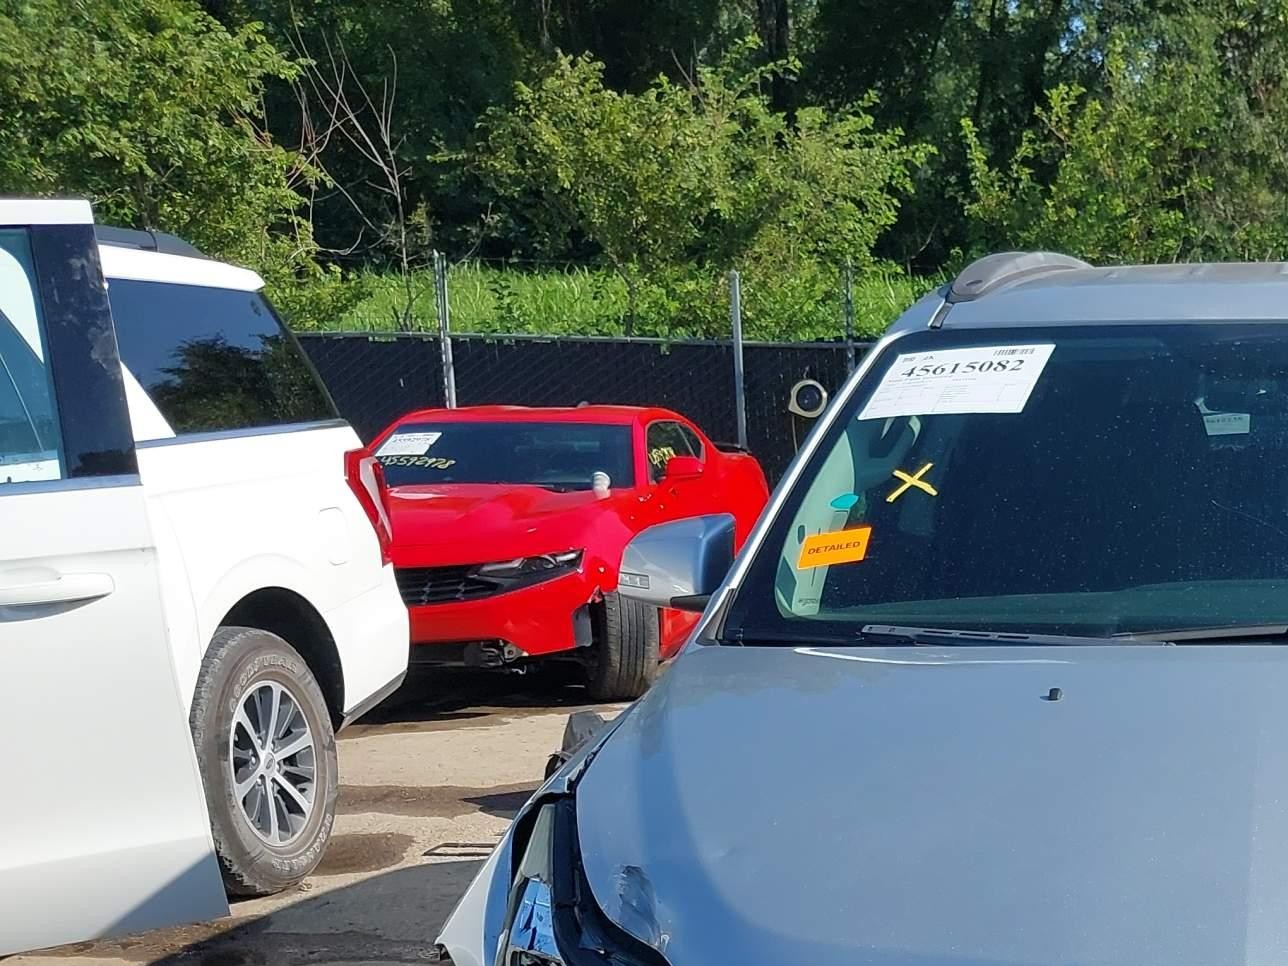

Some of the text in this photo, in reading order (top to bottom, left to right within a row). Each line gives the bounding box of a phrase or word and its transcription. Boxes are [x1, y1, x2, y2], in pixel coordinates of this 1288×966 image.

[901, 359, 1025, 378] 45615082
[380, 456, 456, 470] 45592978
[807, 541, 861, 555] DETAILED
